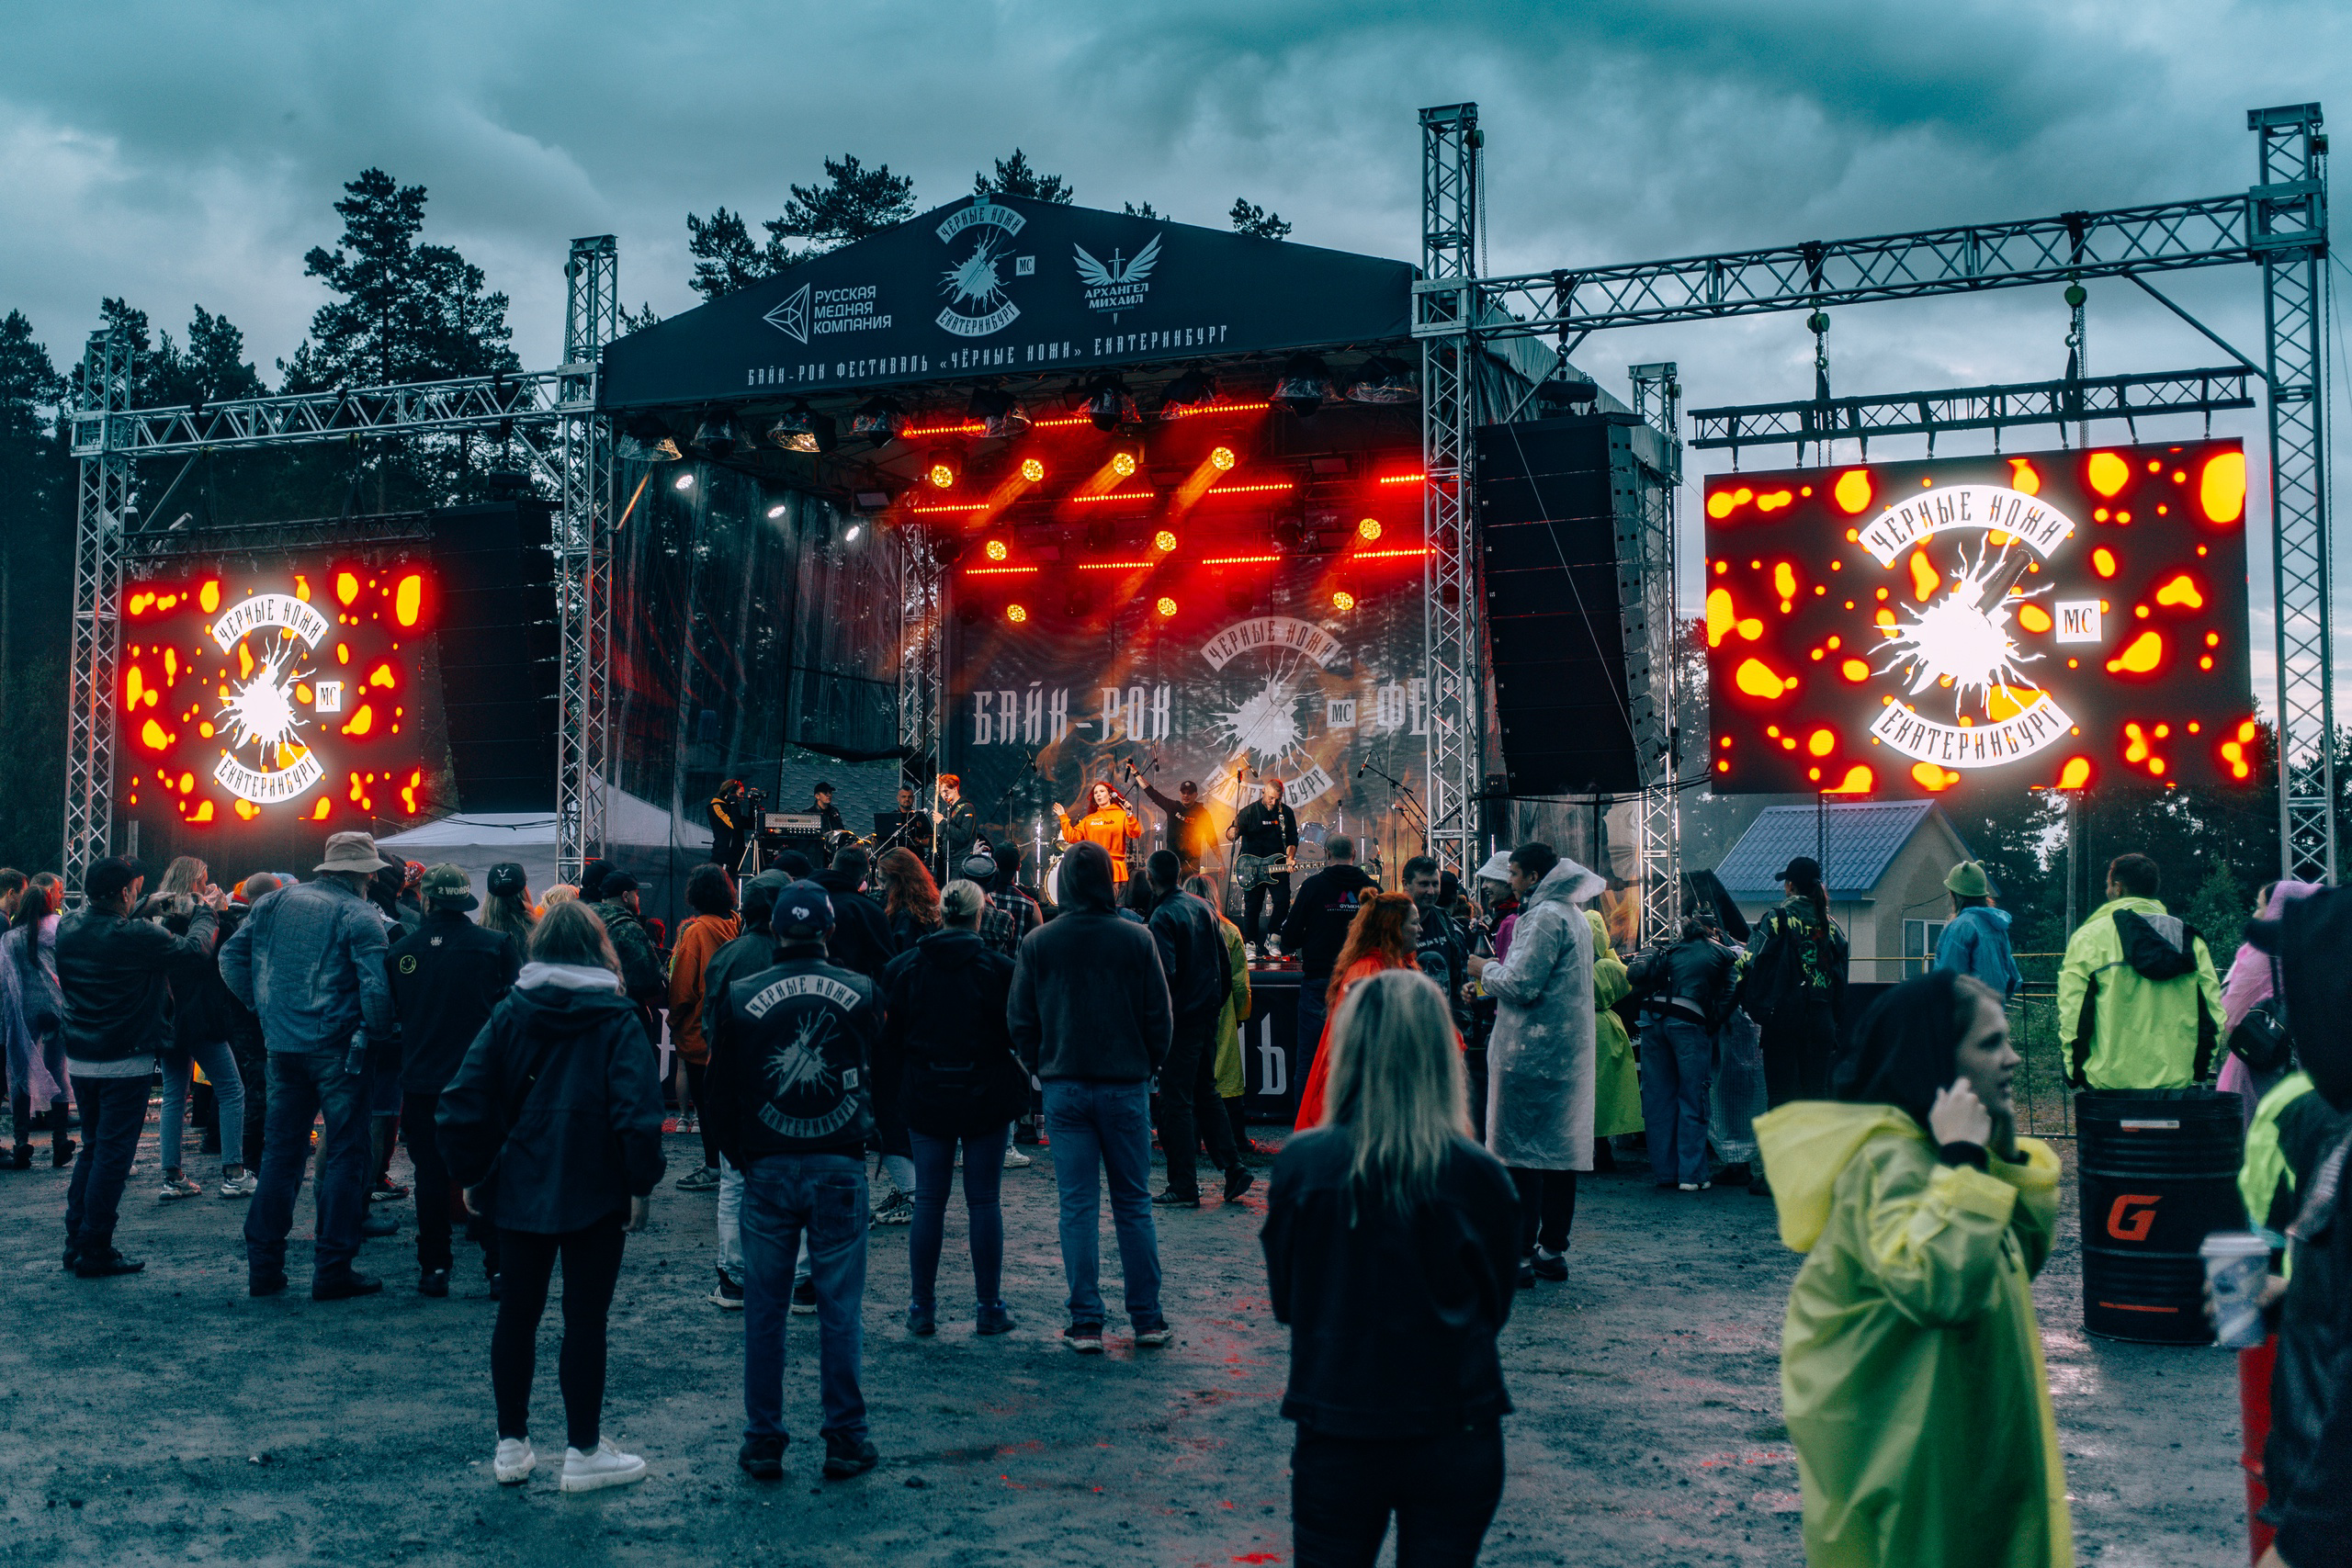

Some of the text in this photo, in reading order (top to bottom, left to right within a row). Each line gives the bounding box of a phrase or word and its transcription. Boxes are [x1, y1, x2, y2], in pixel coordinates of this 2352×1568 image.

[990, 207, 1022, 231] НОЖИ
[814, 285, 876, 303] РУССКАЯ
[1084, 282, 1149, 299] АРХАНГЕЛ
[1089, 294, 1144, 309] МИХАИЛ
[813, 315, 892, 334] КОМПАНИЯ
[814, 301, 874, 319] МЕДНАЯ
[939, 303, 1015, 334] ЕКАТЕРИНБУРГ
[836, 355, 928, 378] ФЕСТИВАЛЬ
[1027, 341, 1081, 363] НОЖИ»
[1094, 325, 1227, 356] ЕКАТЕРИНБУРГ
[1871, 491, 2062, 552] ЧЁРНЫЕ НОЖИ
[284, 602, 322, 640] НОЖИ
[1208, 620, 1335, 662] ЧЁРНЫЕ НОЖИ
[1880, 703, 2062, 761] ЕКАТЕРИНБУРГ
[219, 756, 317, 797] ЕКАТЕРИНБУРГ
[446, 885, 470, 896] WORDS
[817, 977, 855, 1006] НОЖИ
[761, 1098, 855, 1136] ЕКАТЕРИНБУРГ
